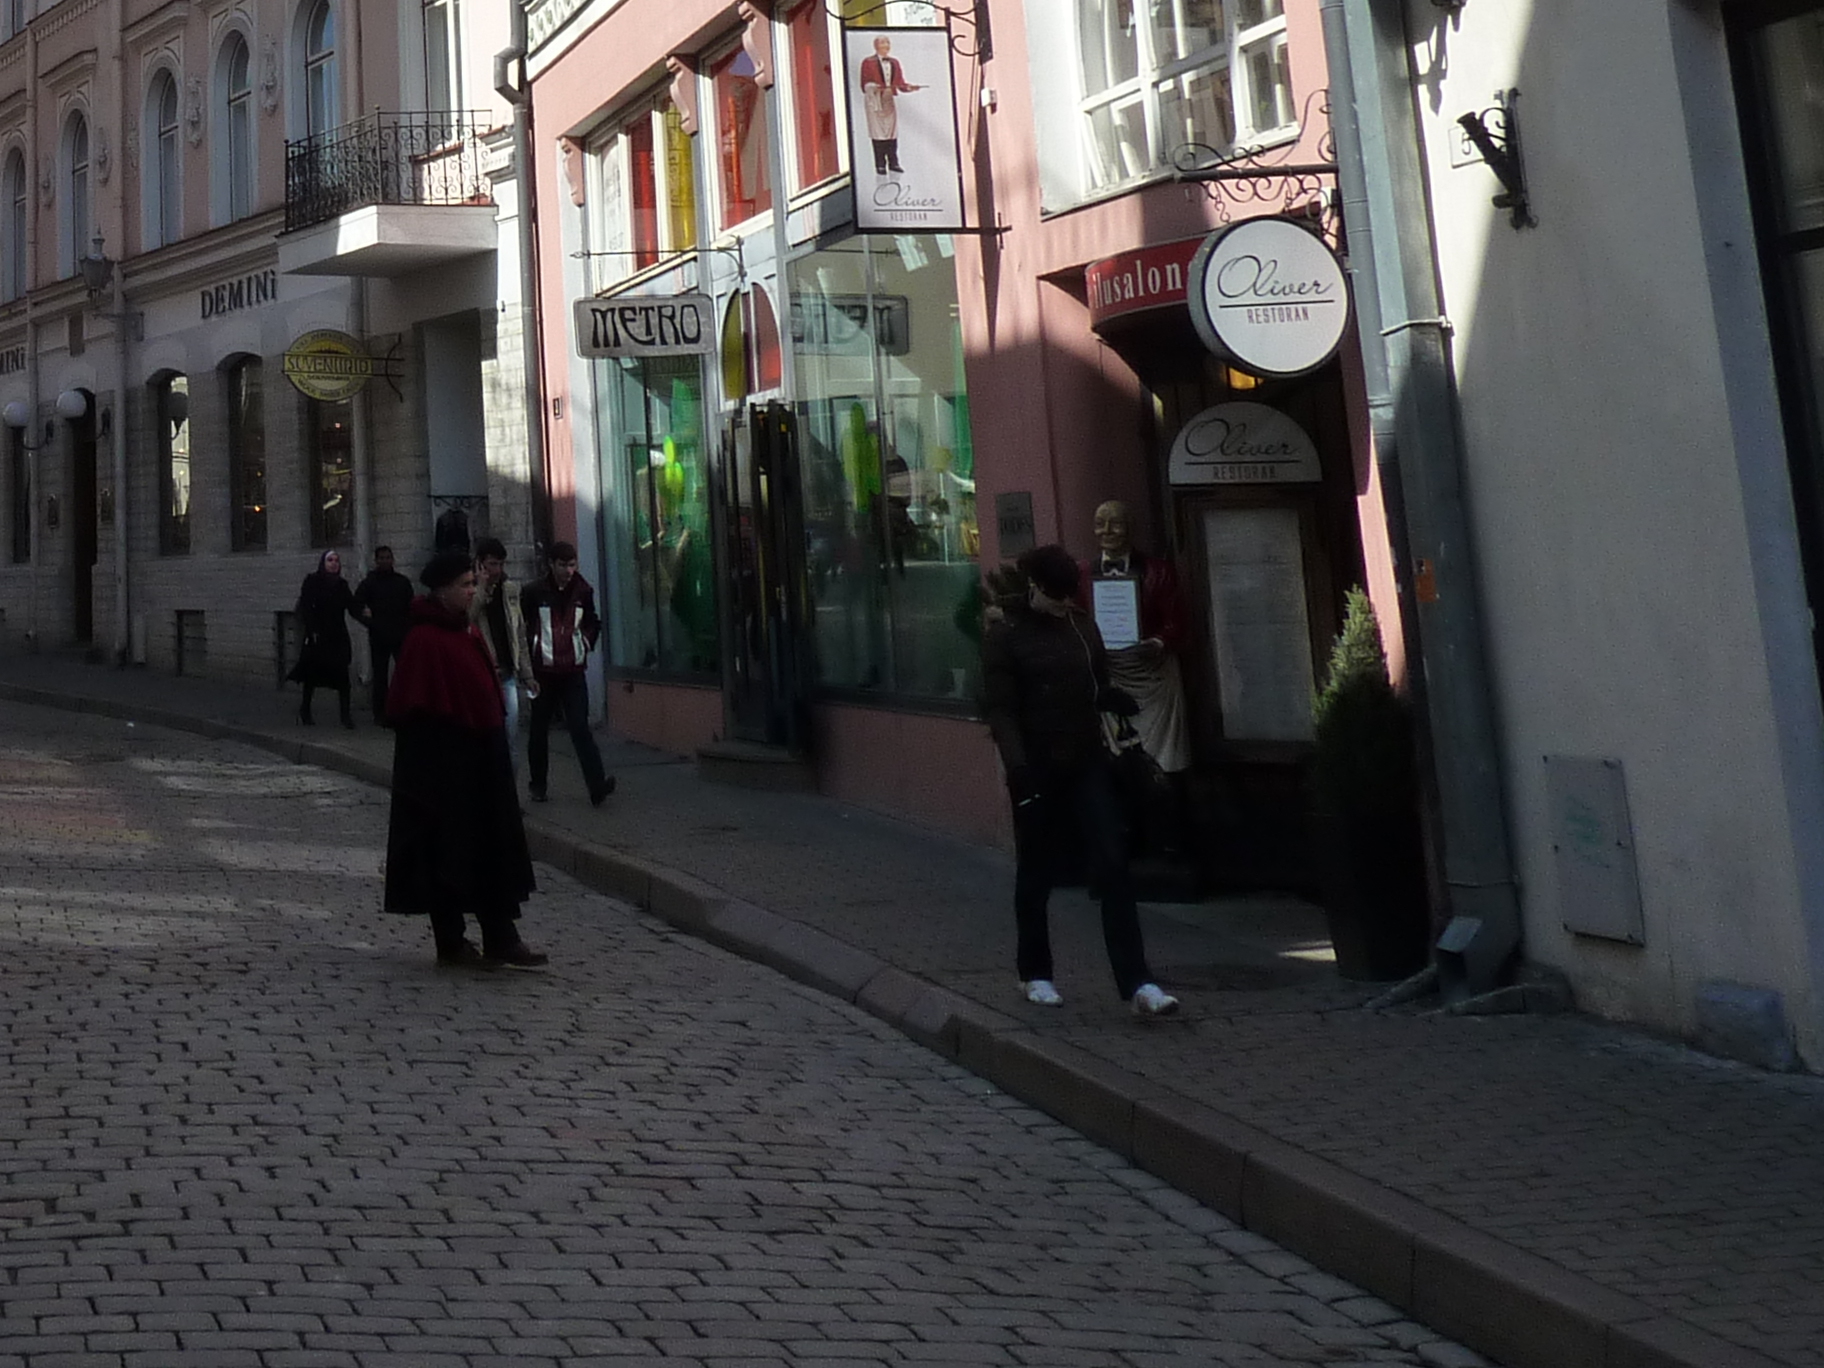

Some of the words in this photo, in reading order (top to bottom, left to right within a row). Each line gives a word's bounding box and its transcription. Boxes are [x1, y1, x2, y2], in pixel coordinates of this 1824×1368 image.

[873, 181, 943, 207] Oliver
[890, 212, 928, 222] RESTORAN
[1216, 254, 1334, 298] Oliver
[591, 303, 702, 347] METRO
[1246, 306, 1310, 324] RESTORAN
[1184, 417, 1302, 457] Oliver
[1212, 464, 1277, 480] RESTORAN
